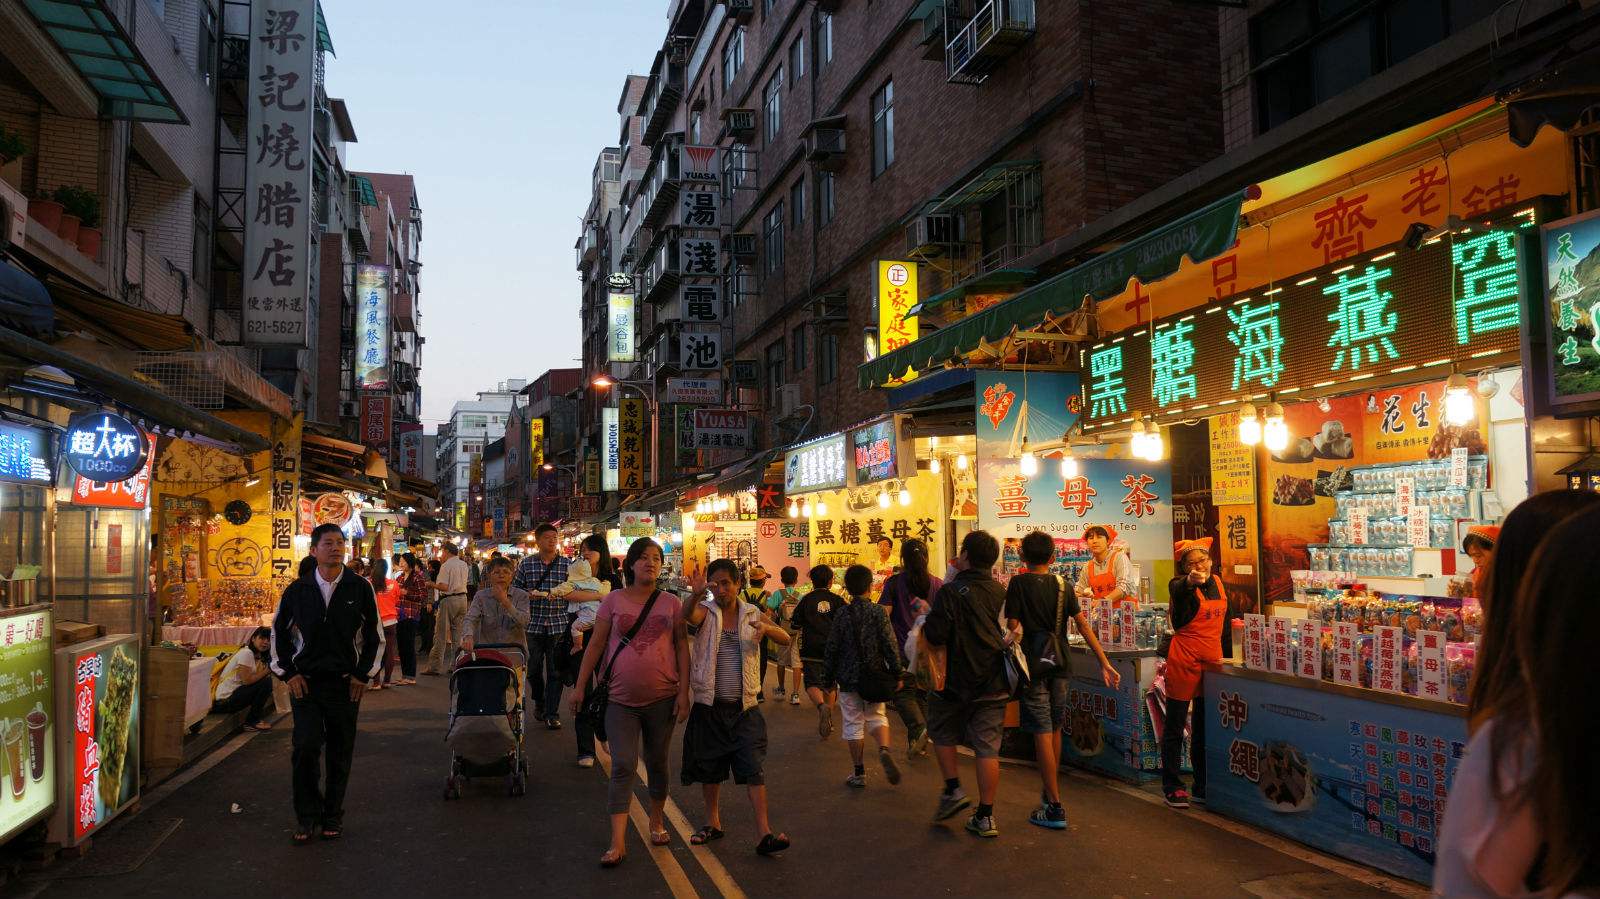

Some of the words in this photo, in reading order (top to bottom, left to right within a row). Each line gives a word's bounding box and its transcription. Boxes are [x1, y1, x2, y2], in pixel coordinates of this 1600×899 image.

[685, 172, 716, 180] YUASA
[684, 193, 717, 368] 湯淺電池
[1557, 233, 1583, 364] 天然養生
[248, 296, 304, 312] 便當外送
[364, 291, 382, 365] 海風餐廳
[616, 314, 628, 353] 曼谷包
[70, 416, 137, 459] 超大杯
[699, 411, 745, 428] YUASA
[699, 433, 745, 447] 湯淺電池
[609, 423, 618, 469] BIRKENSTOCK
[994, 474, 1158, 518] 薑母茶
[815, 518, 937, 545] 黑糖薑母茶
[1016, 523, 1046, 532] Brown
[1050, 523, 1078, 533] Sugar
[1120, 522, 1137, 531] Tea
[788, 541, 809, 558] 理
[1249, 617, 1261, 667] 冰糖菊花
[1424, 635, 1439, 695] 薑母茶
